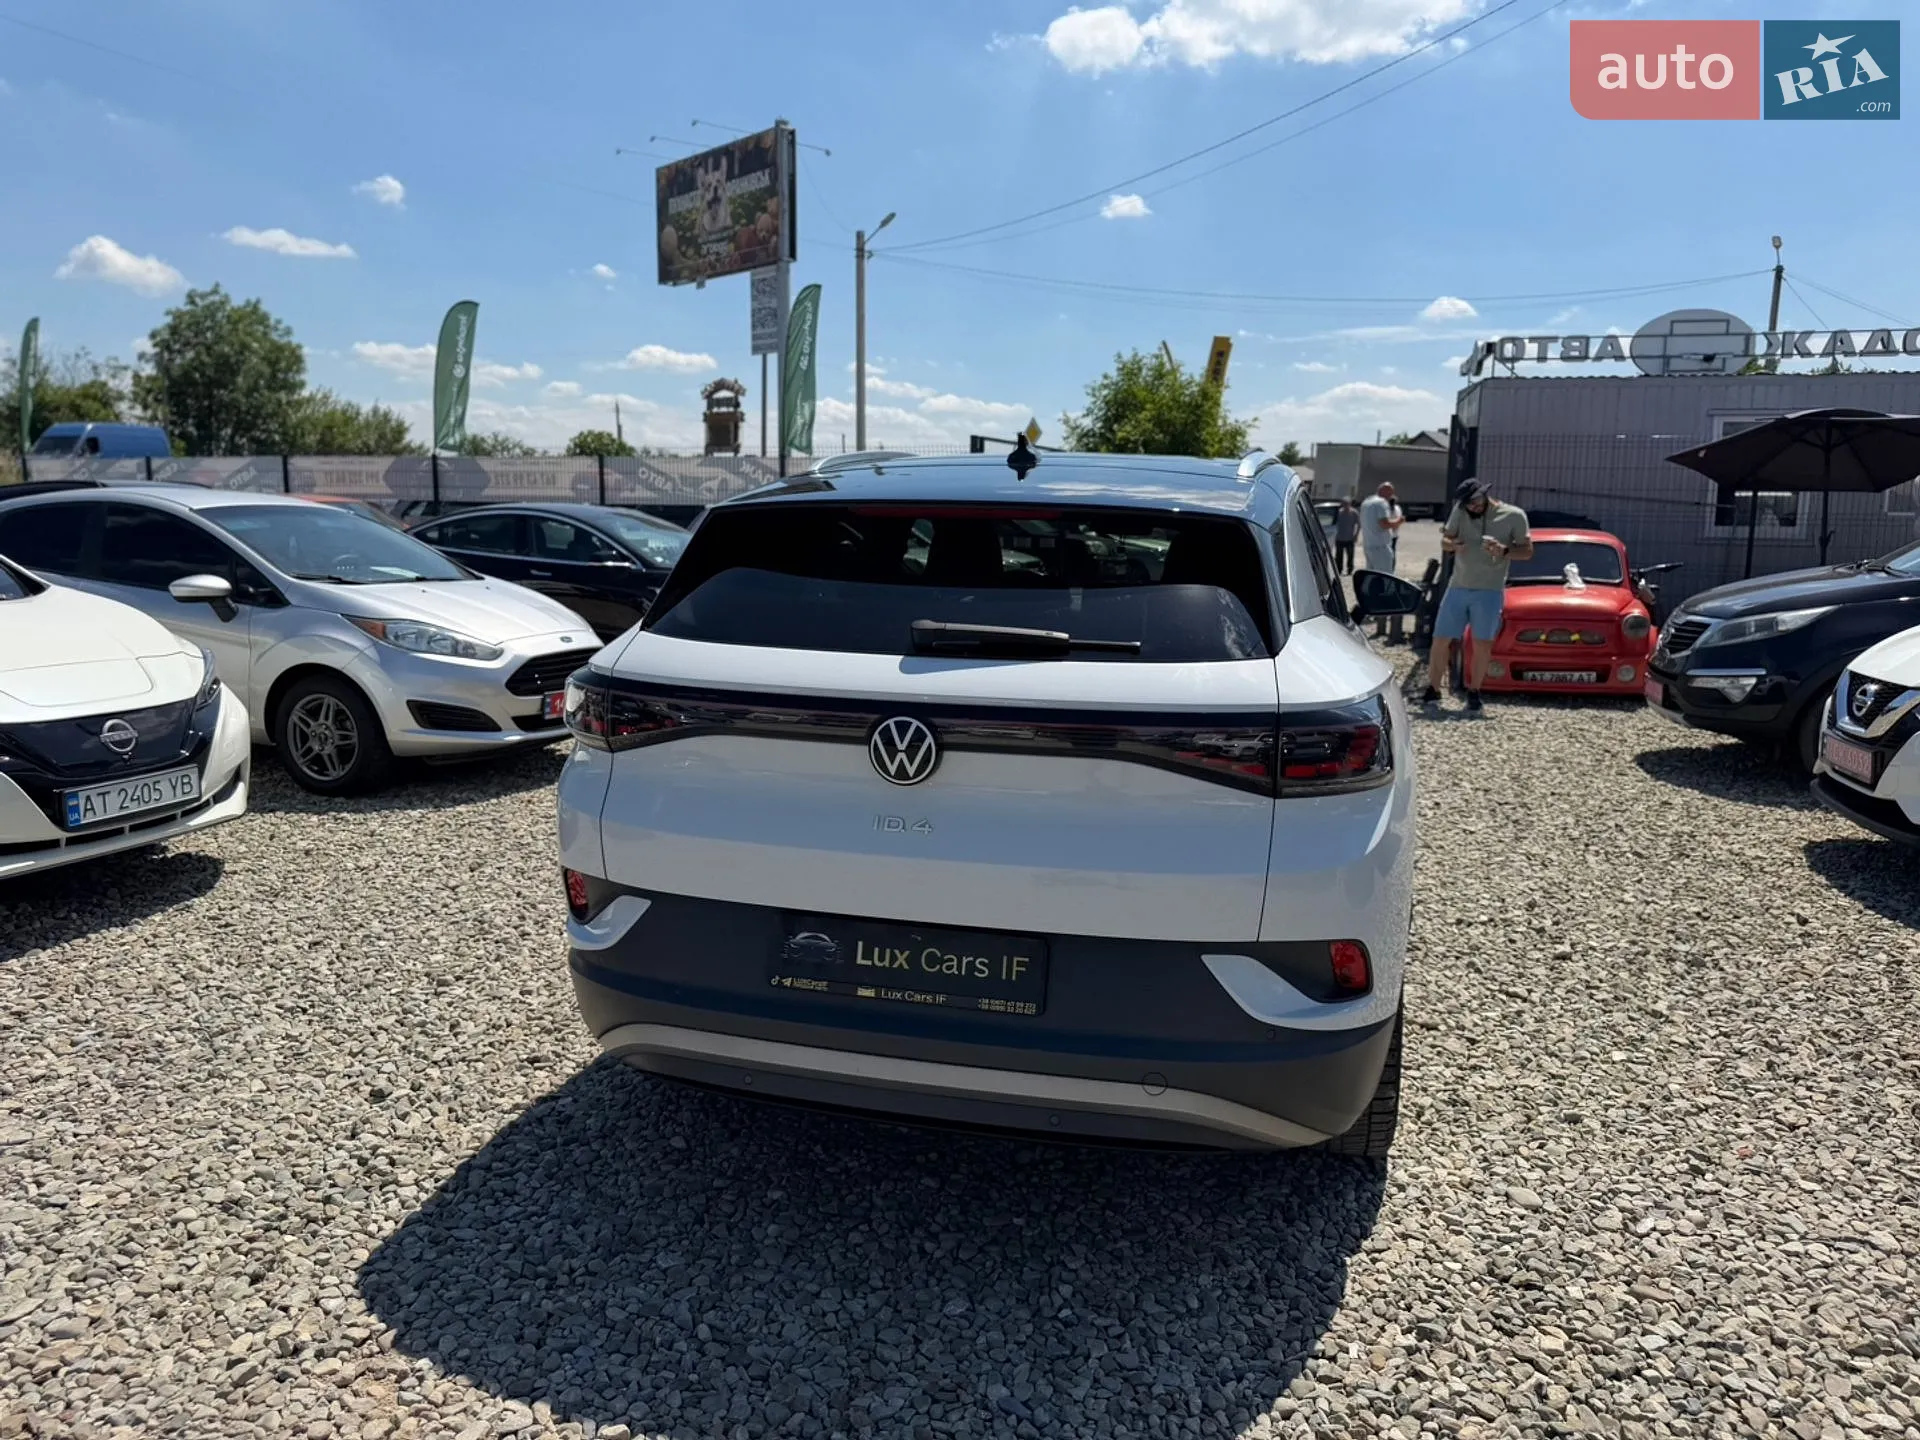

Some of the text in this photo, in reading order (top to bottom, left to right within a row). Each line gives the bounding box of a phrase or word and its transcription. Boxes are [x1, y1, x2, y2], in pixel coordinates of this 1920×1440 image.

[83, 773, 194, 818] AT 2405 YB
[855, 940, 1030, 981] Lux Cars IF
[881, 988, 949, 1005] Lux Cars IF
